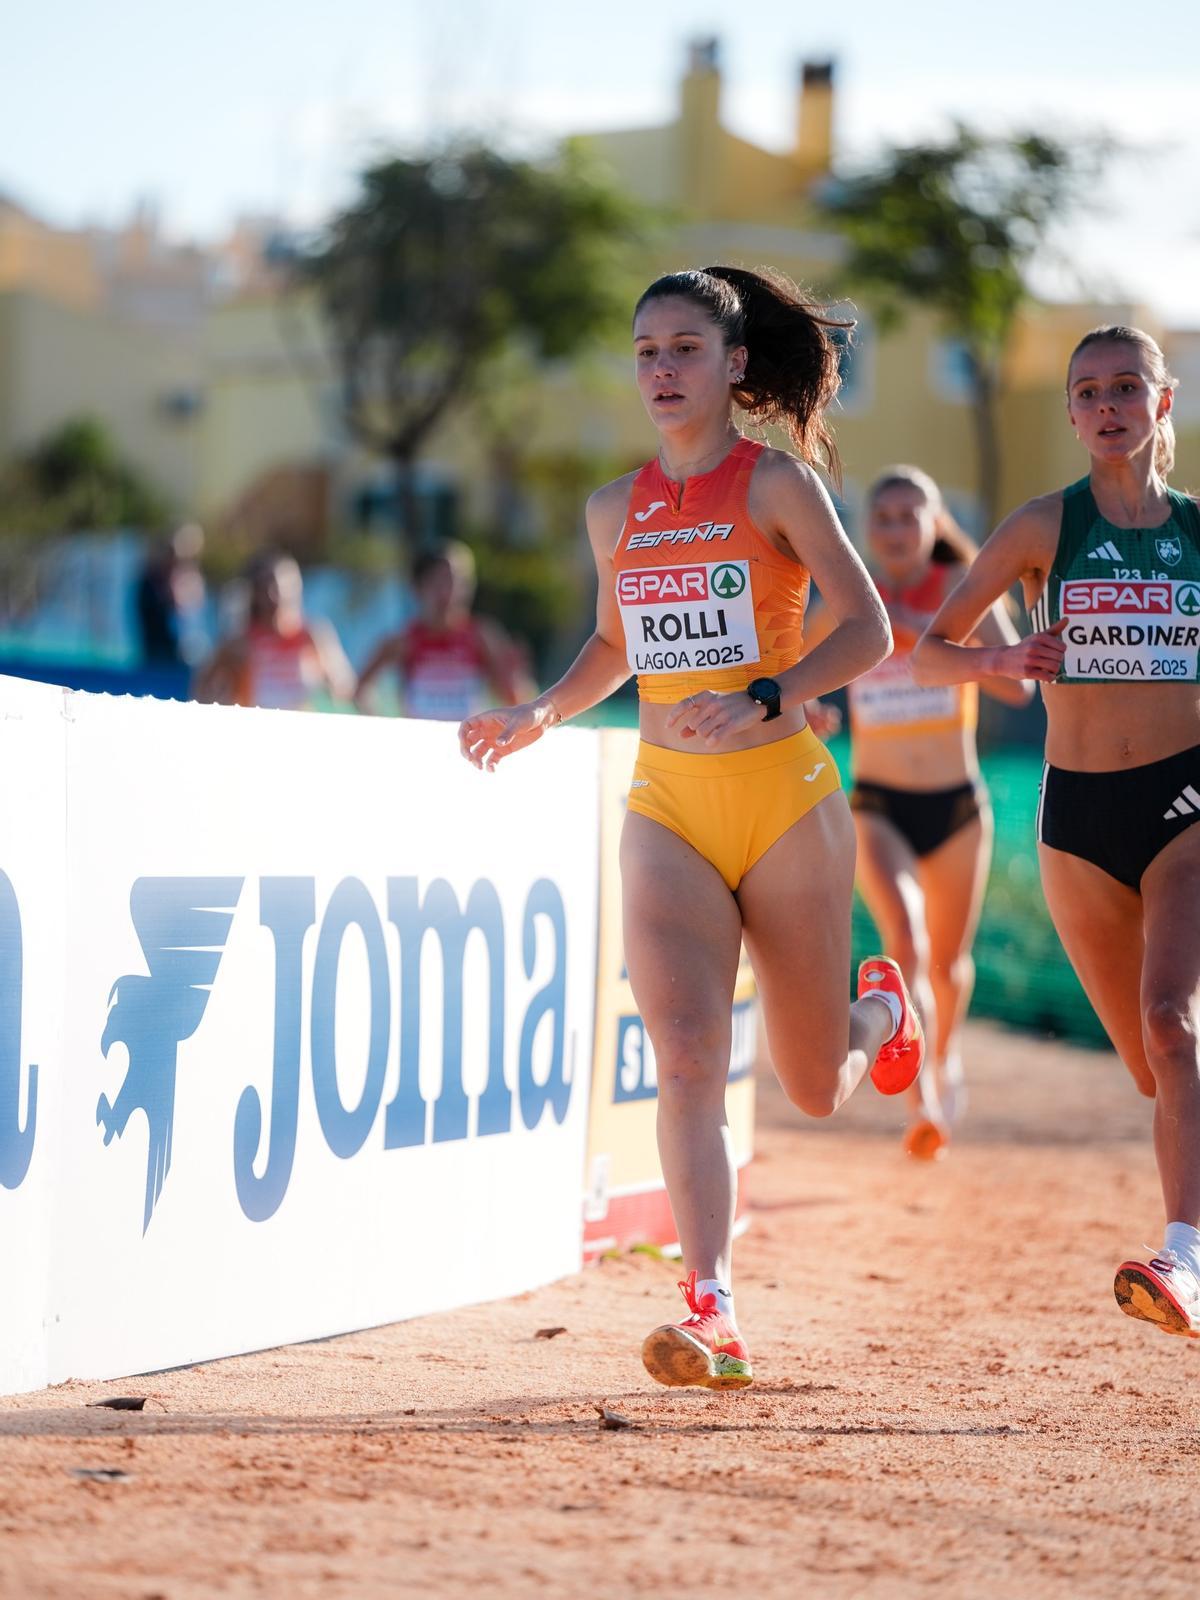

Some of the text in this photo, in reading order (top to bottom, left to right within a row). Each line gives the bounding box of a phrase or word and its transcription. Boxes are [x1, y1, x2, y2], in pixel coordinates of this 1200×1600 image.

[626, 521, 735, 551] ESPAÑA
[621, 572, 705, 601] SPAR
[1066, 586, 1169, 610] SPAR
[641, 609, 728, 643] ROLLI
[1068, 625, 1199, 646] GARDINER
[636, 644, 744, 670] LAGOA 2025
[1077, 657, 1188, 676] LAGOA 2025
[233, 875, 577, 1222] Joma
